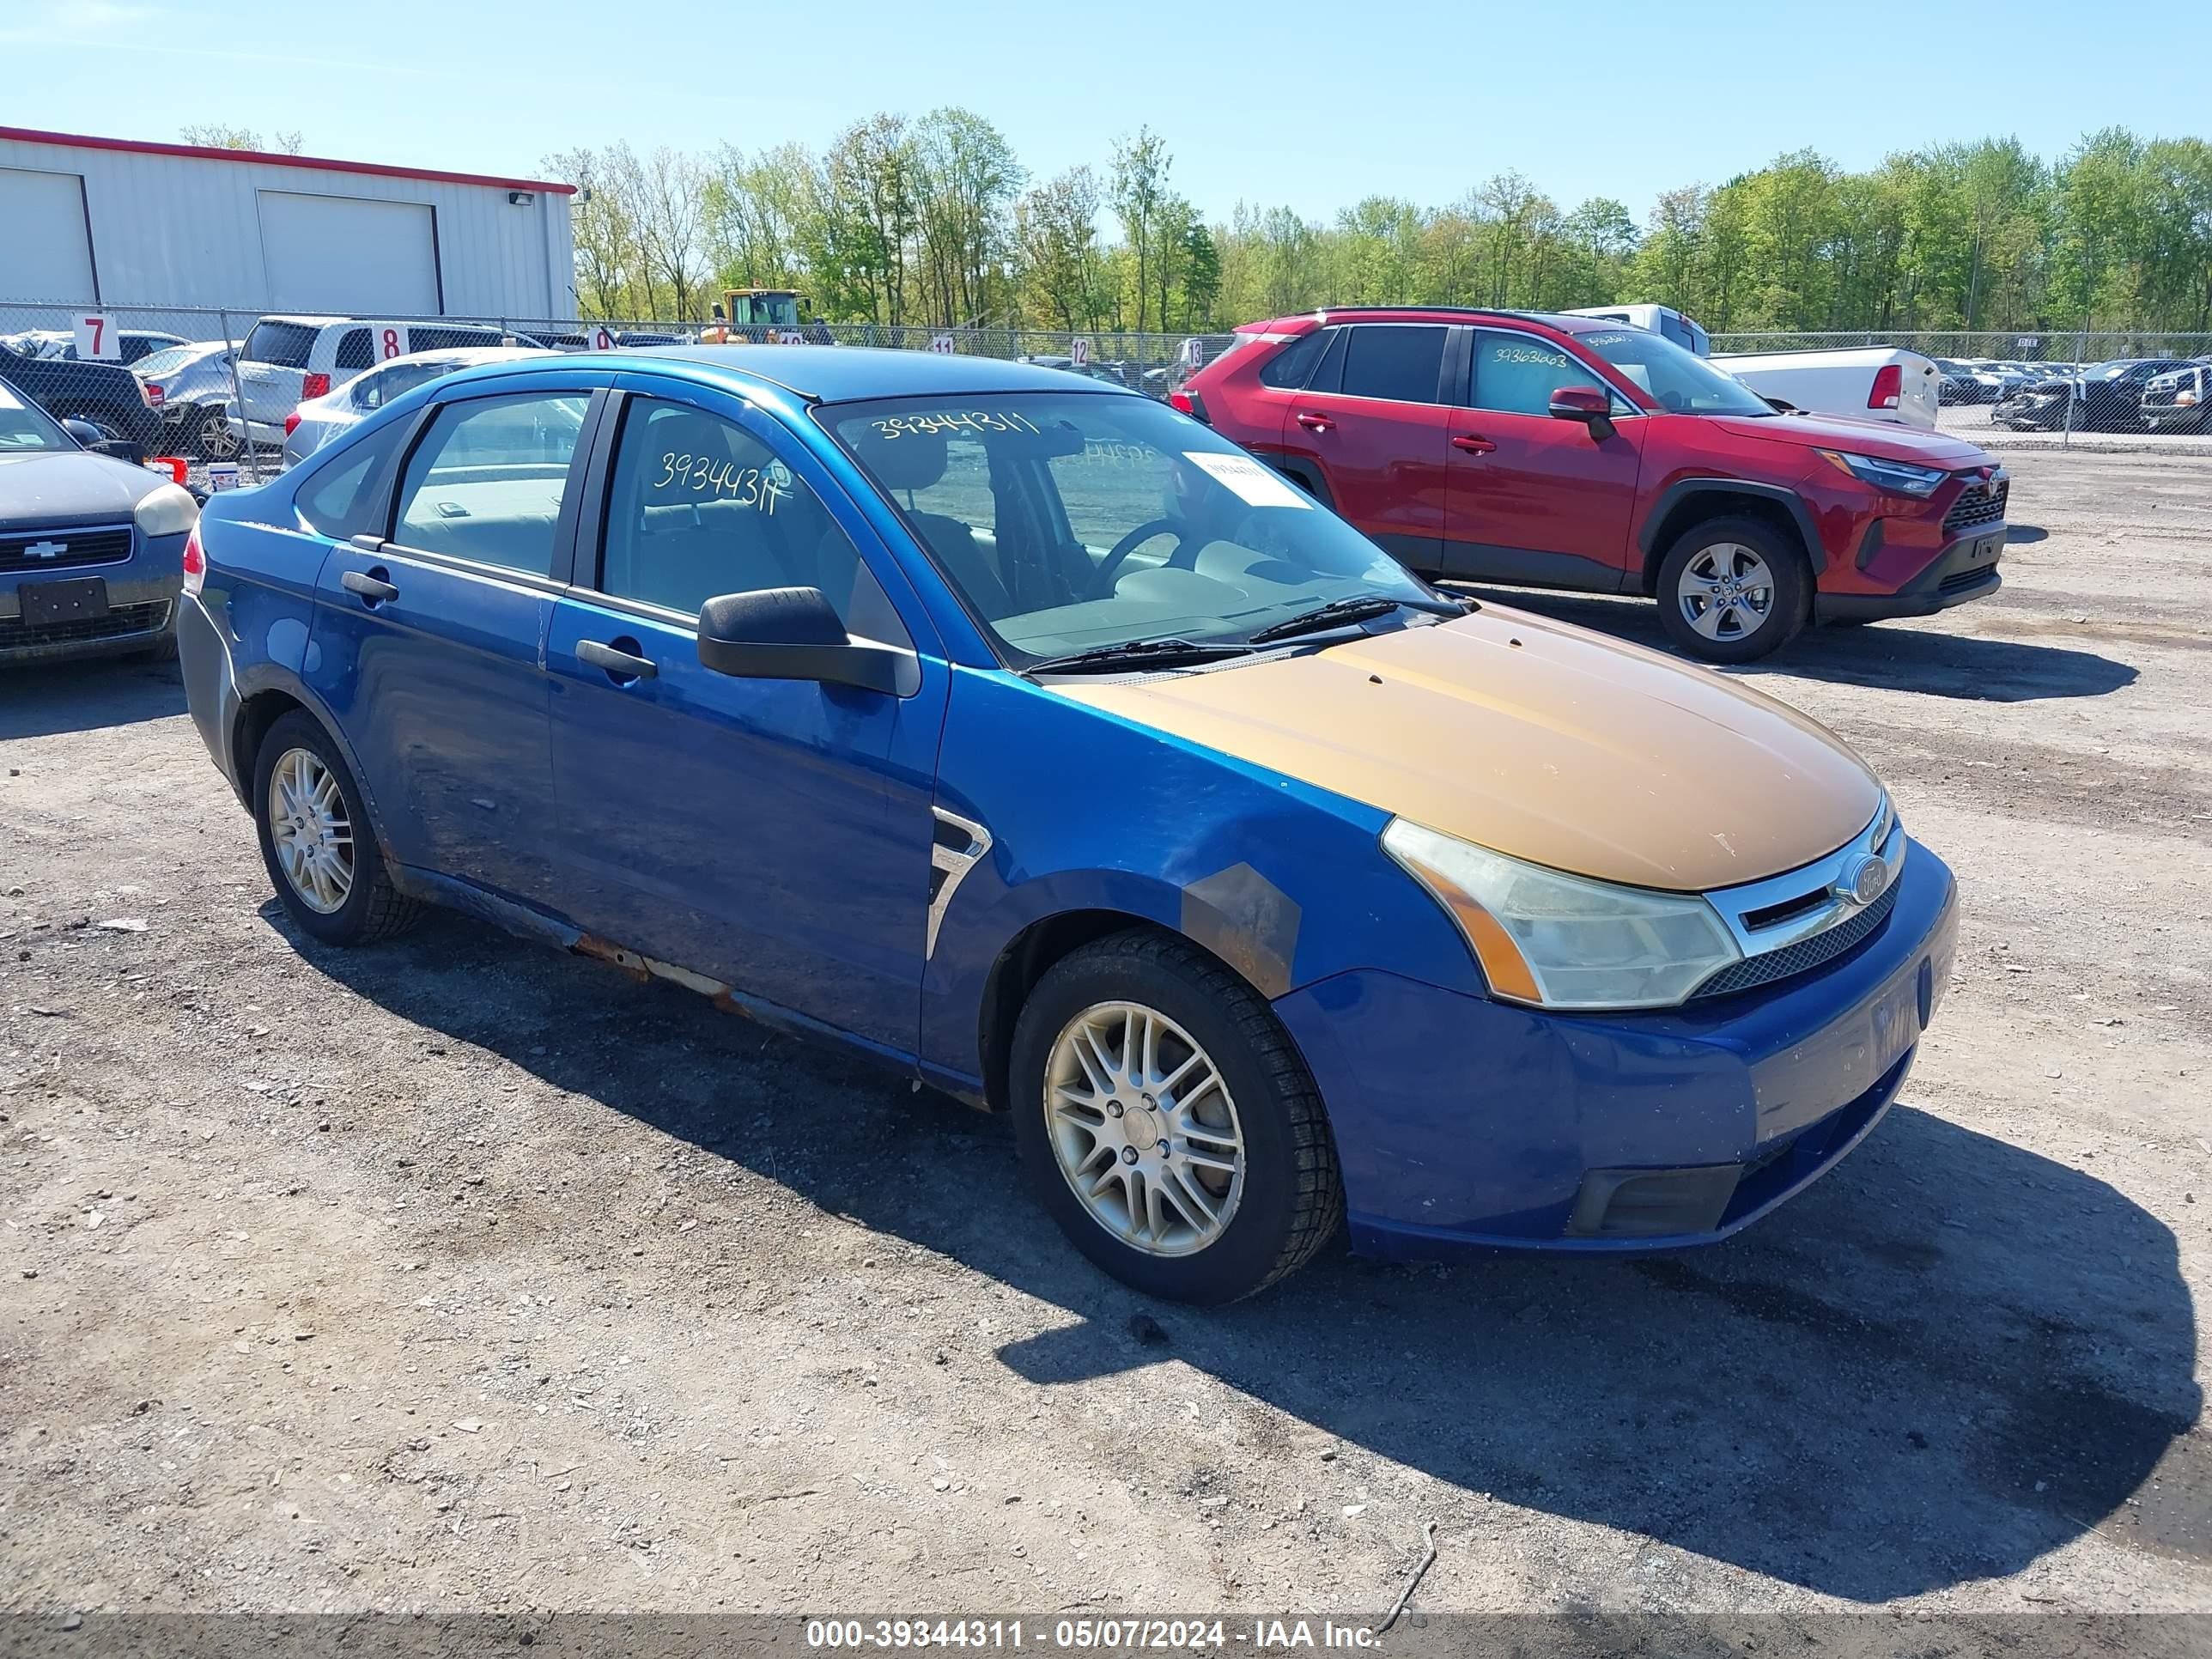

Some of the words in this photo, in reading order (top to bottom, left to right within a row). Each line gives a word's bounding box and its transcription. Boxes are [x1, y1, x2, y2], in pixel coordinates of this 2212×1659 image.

[85, 318, 104, 355] 7
[383, 329, 400, 359] 8
[1073, 342, 1086, 363] 12
[1189, 343, 1201, 364] 13
[872, 411, 1041, 440] 39344311
[654, 453, 780, 516] 39344311
[1863, 865, 1882, 896] Ford
